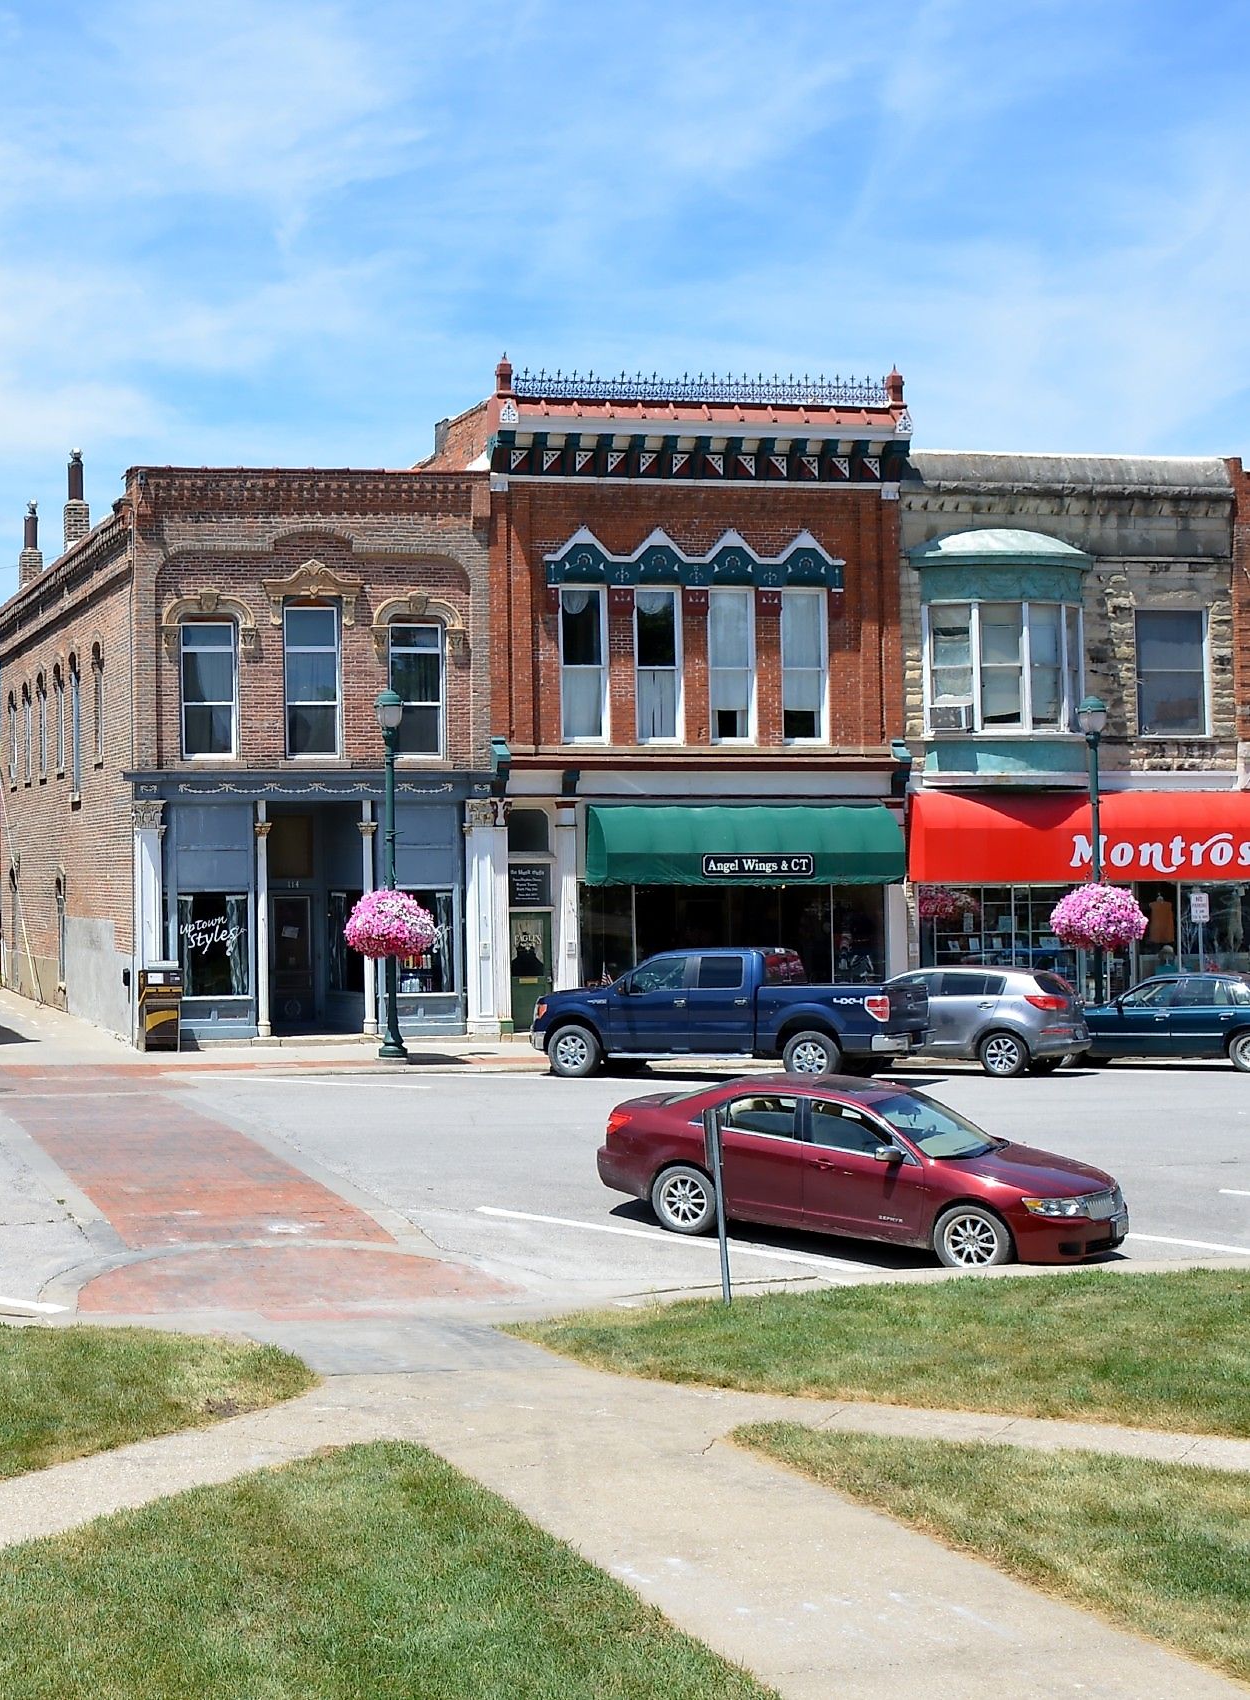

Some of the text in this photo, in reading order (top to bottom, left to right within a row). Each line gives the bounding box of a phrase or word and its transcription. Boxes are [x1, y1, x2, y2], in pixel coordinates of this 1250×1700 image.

[708, 858, 809, 874] Angel Wings & CT
[188, 924, 239, 955] Styles
